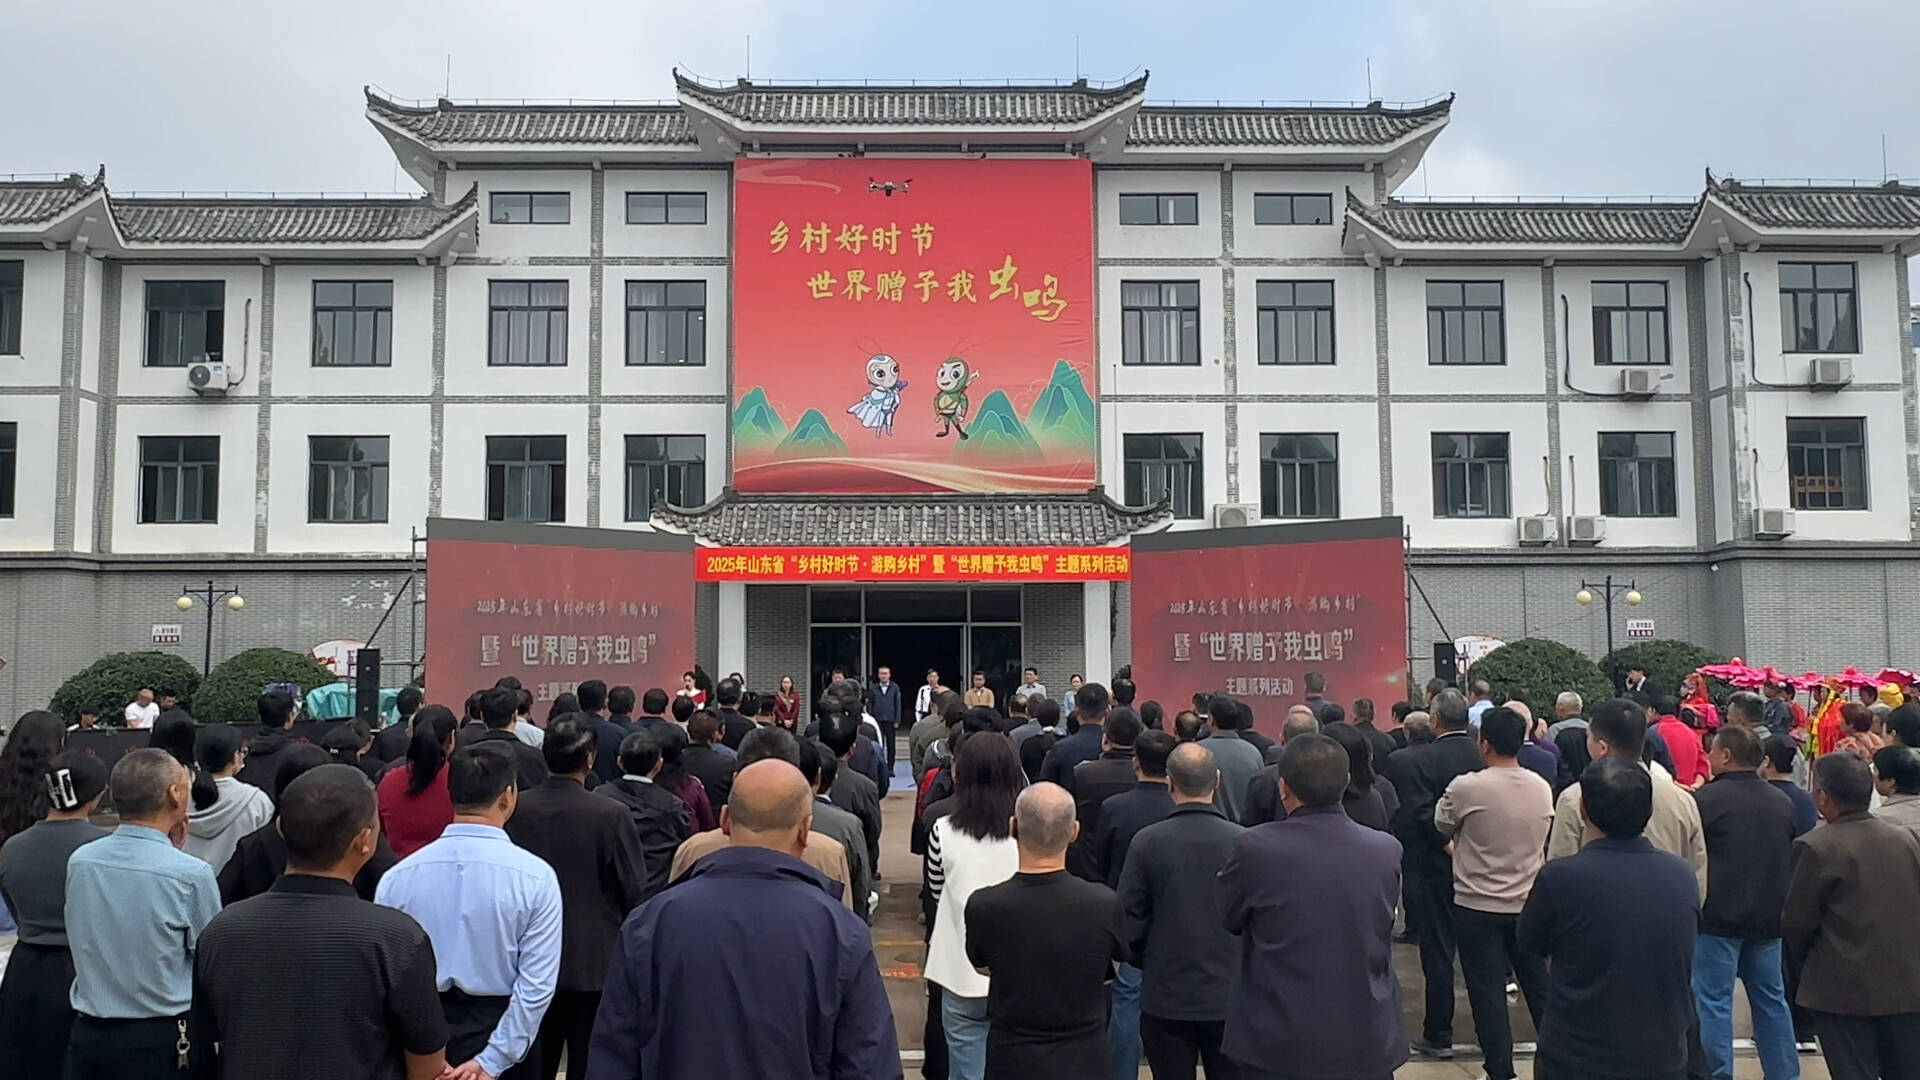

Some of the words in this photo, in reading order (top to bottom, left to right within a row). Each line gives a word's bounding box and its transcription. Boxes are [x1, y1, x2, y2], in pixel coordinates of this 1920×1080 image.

[768, 220, 937, 256] 乡村好时节
[1226, 676, 1294, 697] 主题系列活动
